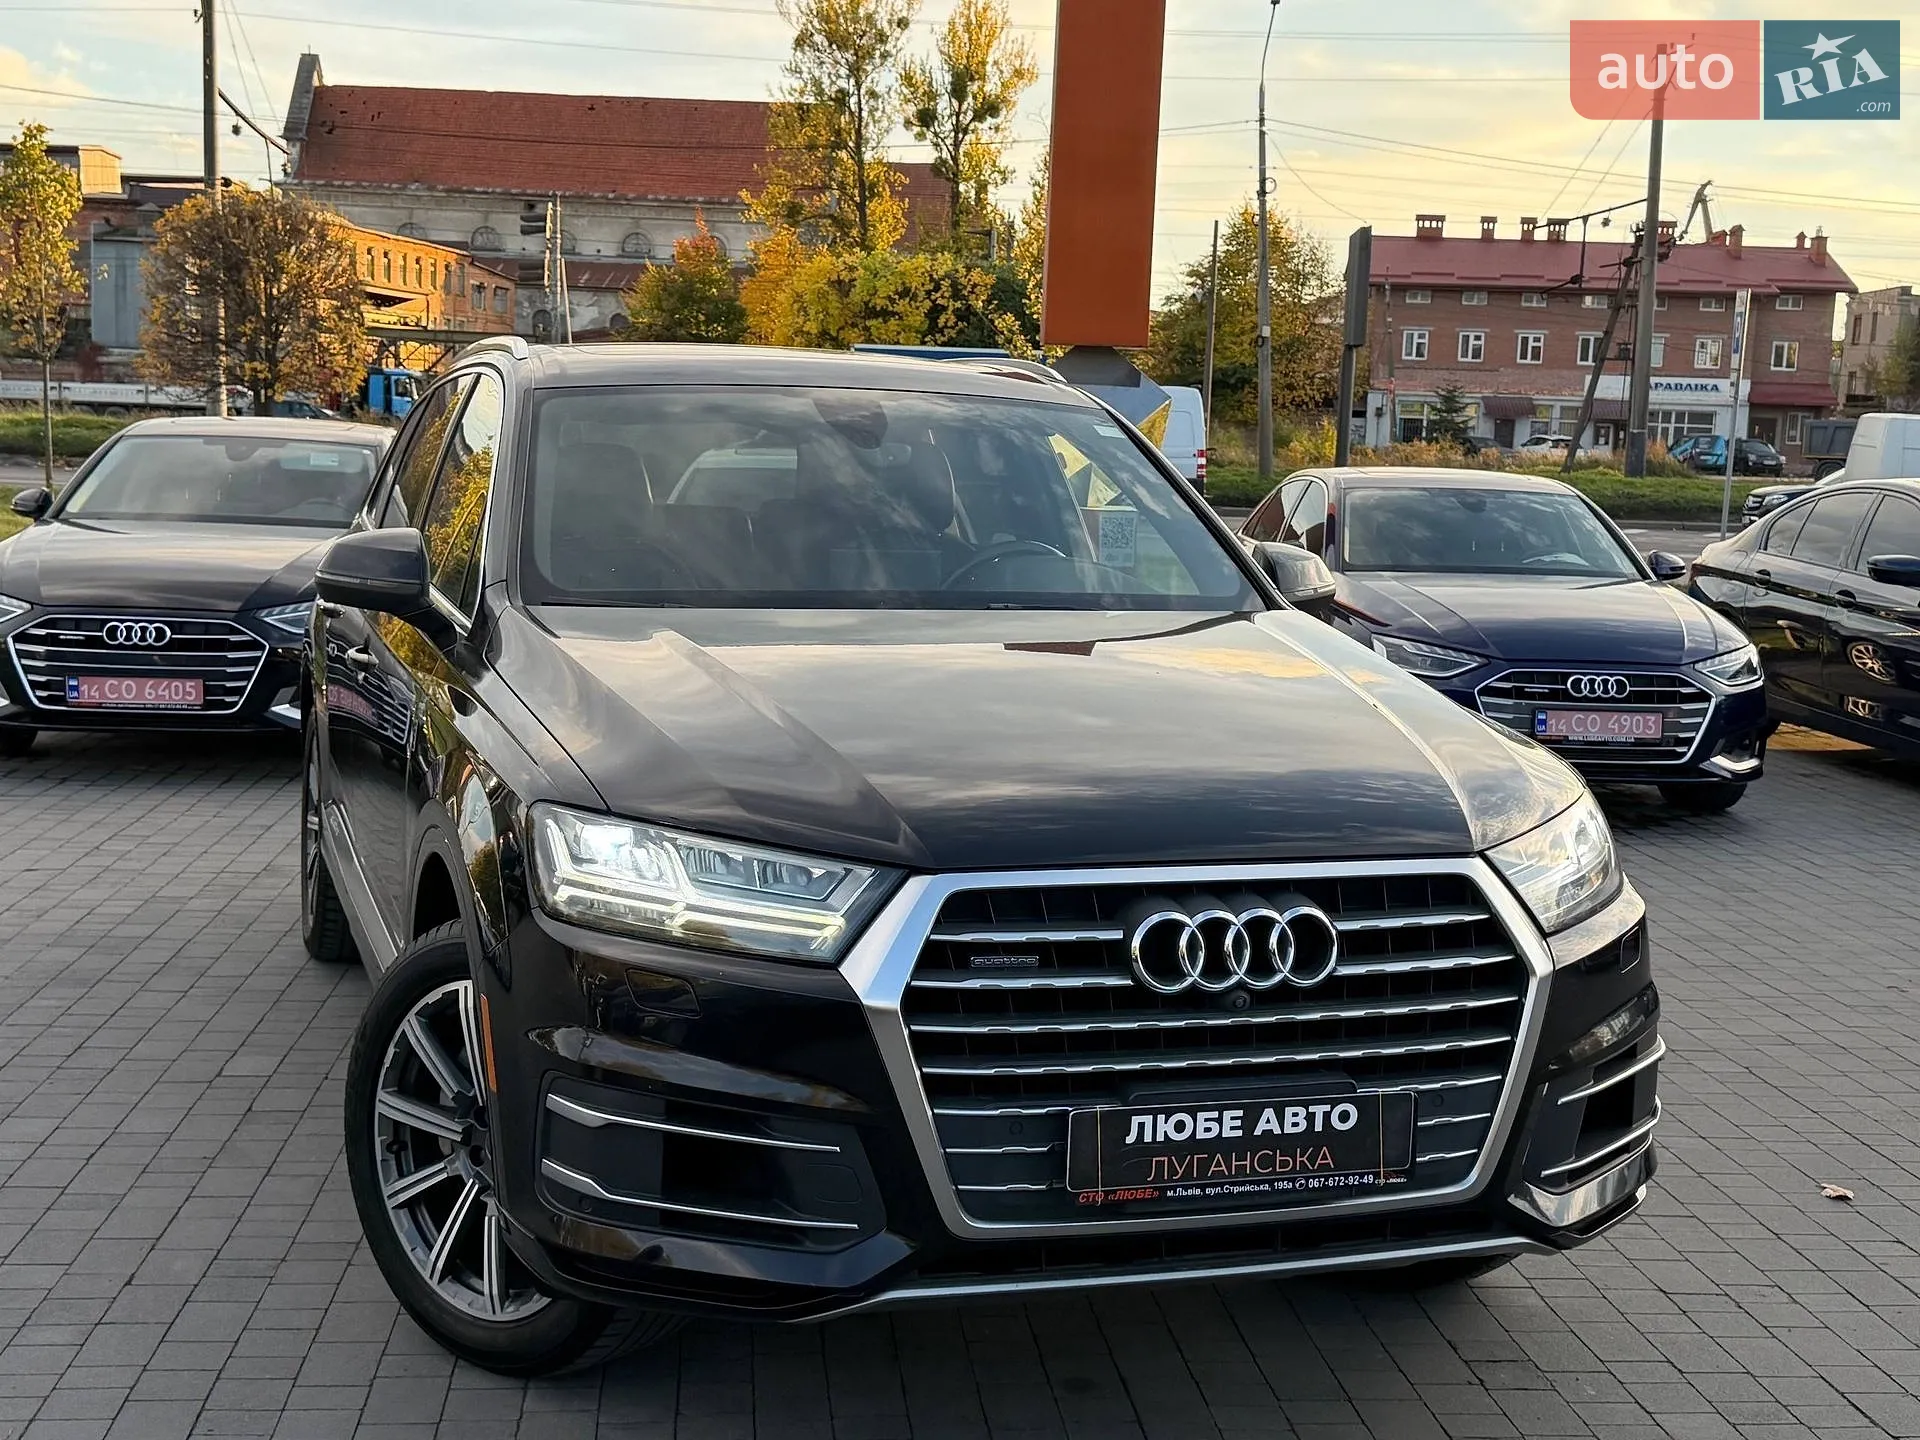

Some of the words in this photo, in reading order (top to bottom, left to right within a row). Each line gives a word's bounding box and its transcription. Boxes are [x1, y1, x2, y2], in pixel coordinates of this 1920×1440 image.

[81, 684, 99, 700] 14
[105, 680, 136, 699] CO
[145, 680, 196, 701] 6405
[1549, 718, 1566, 733] 14
[1571, 714, 1600, 732] CO
[1608, 714, 1656, 734] 4903
[974, 957, 1036, 965] quattro
[1125, 1109, 1243, 1144] ЛЮБЕ
[1253, 1102, 1358, 1136] АВТО
[1147, 1146, 1335, 1181] ЛУГАНСЬКА
[1308, 1174, 1374, 1188] 067-672-92-49
